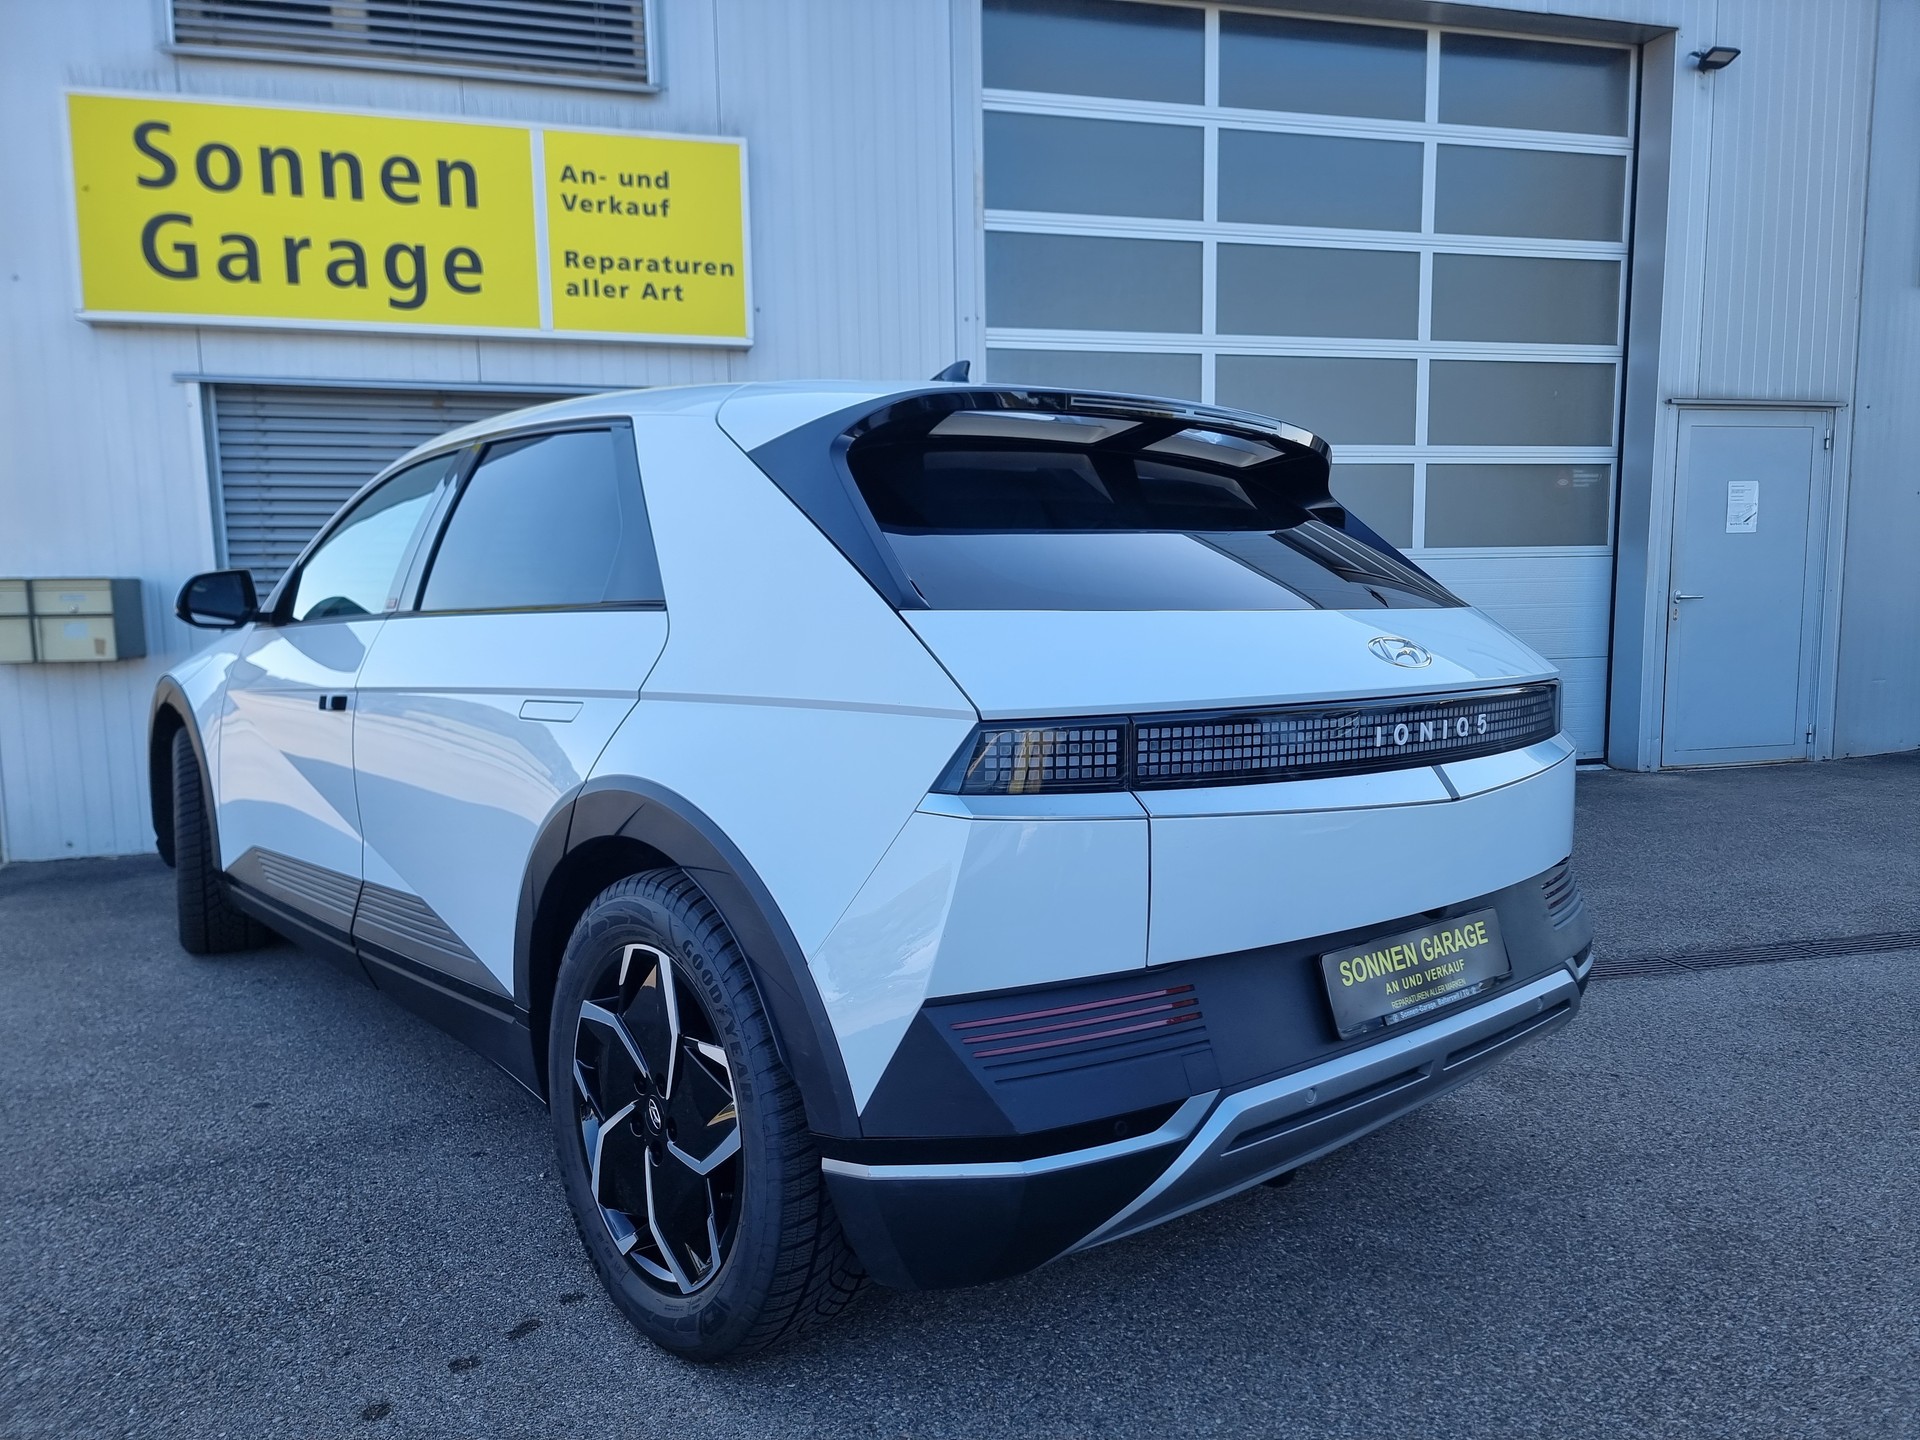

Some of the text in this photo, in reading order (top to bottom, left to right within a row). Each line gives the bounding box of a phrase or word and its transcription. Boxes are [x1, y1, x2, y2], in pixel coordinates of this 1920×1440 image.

[133, 121, 479, 208] Sonnen
[560, 165, 669, 189] An- und
[561, 193, 669, 217] Verkauf
[141, 212, 484, 309] Garage
[564, 250, 735, 277] Reparaturen
[566, 279, 684, 302] aller Art
[1339, 921, 1488, 987] SONNEN GARAGE
[1386, 959, 1465, 995] AN UND VERKAUF
[1391, 978, 1466, 1009] REPARATUREN ALLER MARKEN
